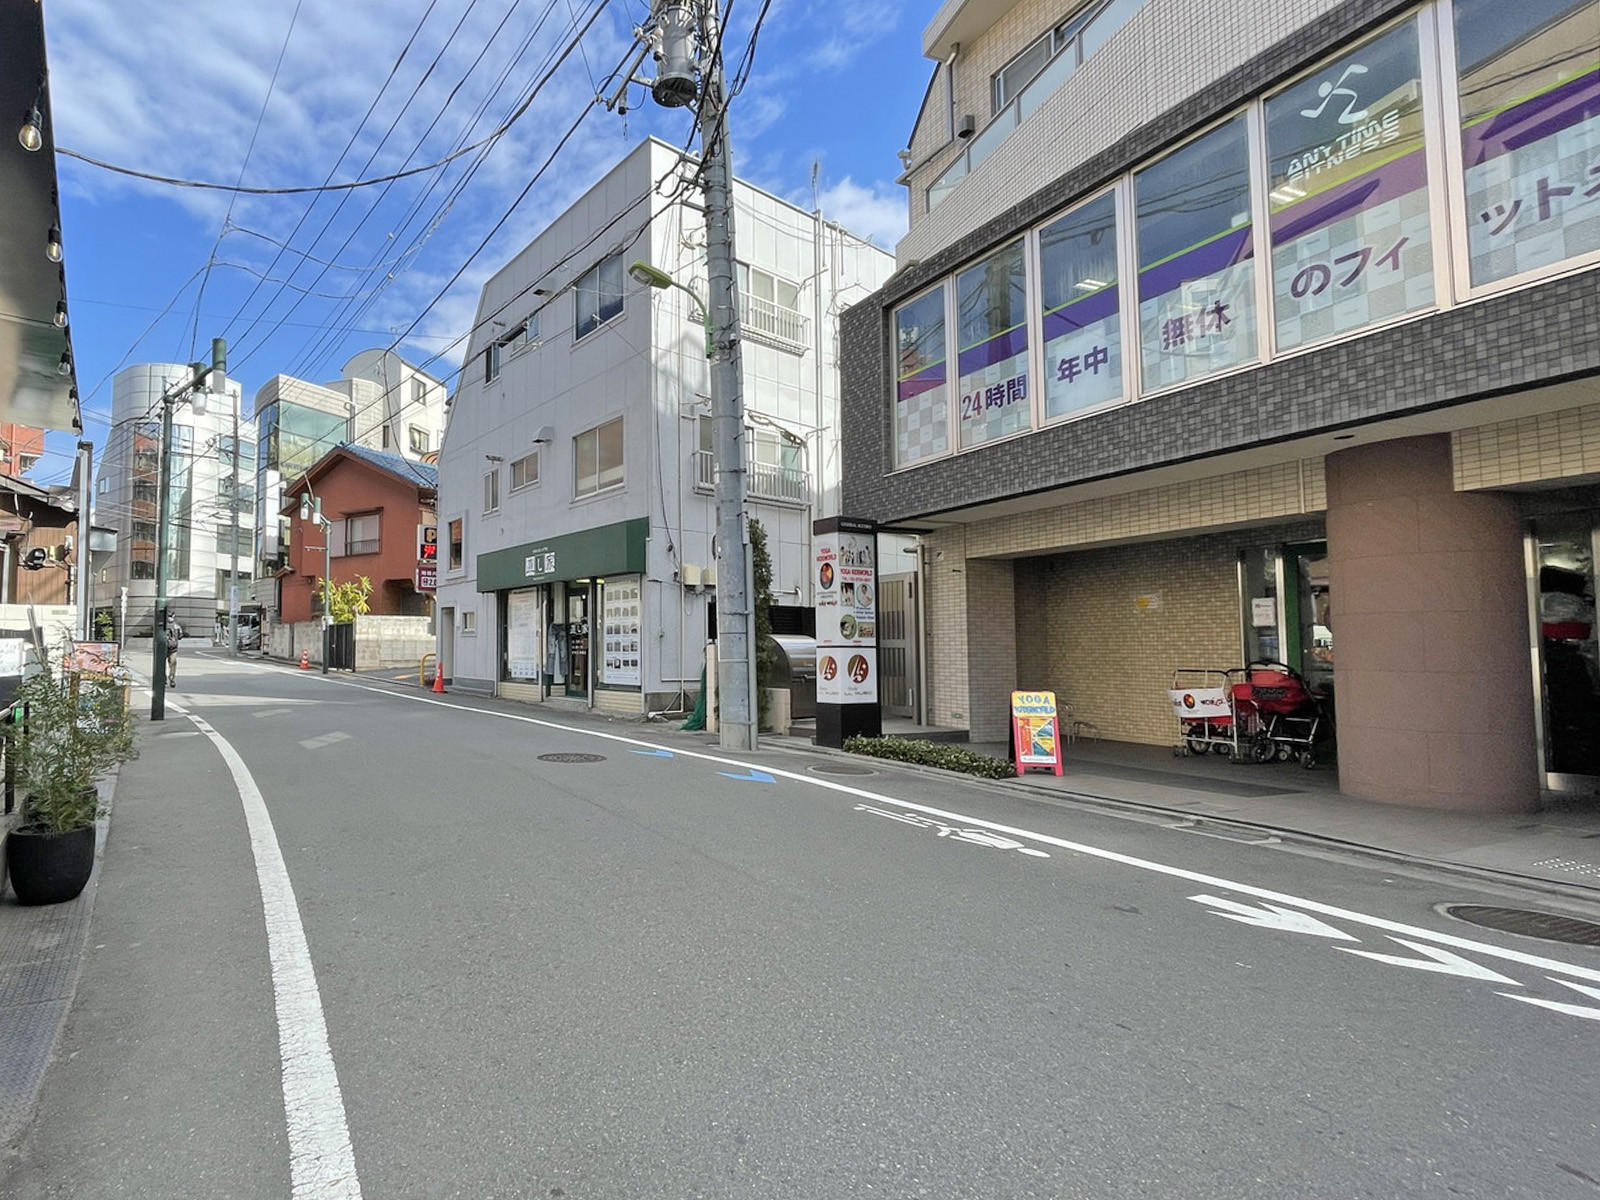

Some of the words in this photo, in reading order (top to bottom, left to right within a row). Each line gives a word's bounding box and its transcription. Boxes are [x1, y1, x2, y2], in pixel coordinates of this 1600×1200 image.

[1288, 124, 1400, 184] FITNESS
[962, 373, 1028, 422] 24時間
[1056, 345, 1108, 384] 年中
[1162, 299, 1232, 350] 無休
[1290, 236, 1410, 298] のフィ
[1018, 695, 1051, 705] YOGA
